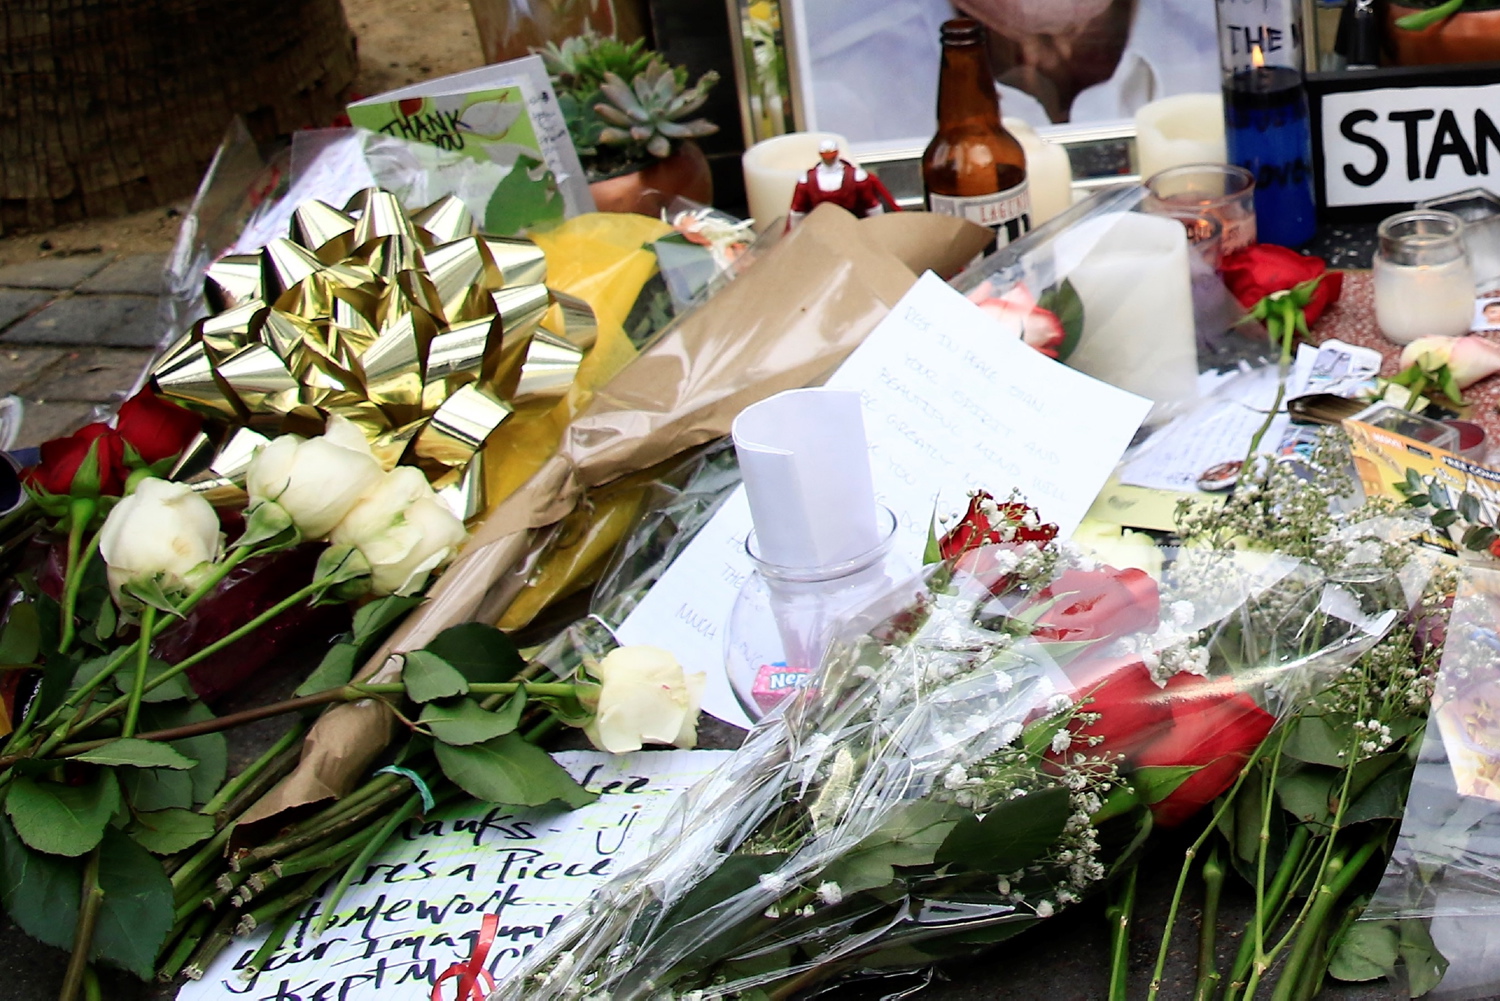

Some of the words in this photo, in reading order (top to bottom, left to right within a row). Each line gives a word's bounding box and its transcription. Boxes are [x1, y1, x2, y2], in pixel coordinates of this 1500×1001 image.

[1227, 24, 1282, 54] THE
[379, 109, 472, 141] THANK
[426, 133, 465, 151] YOU
[400, 807, 538, 847] anks
